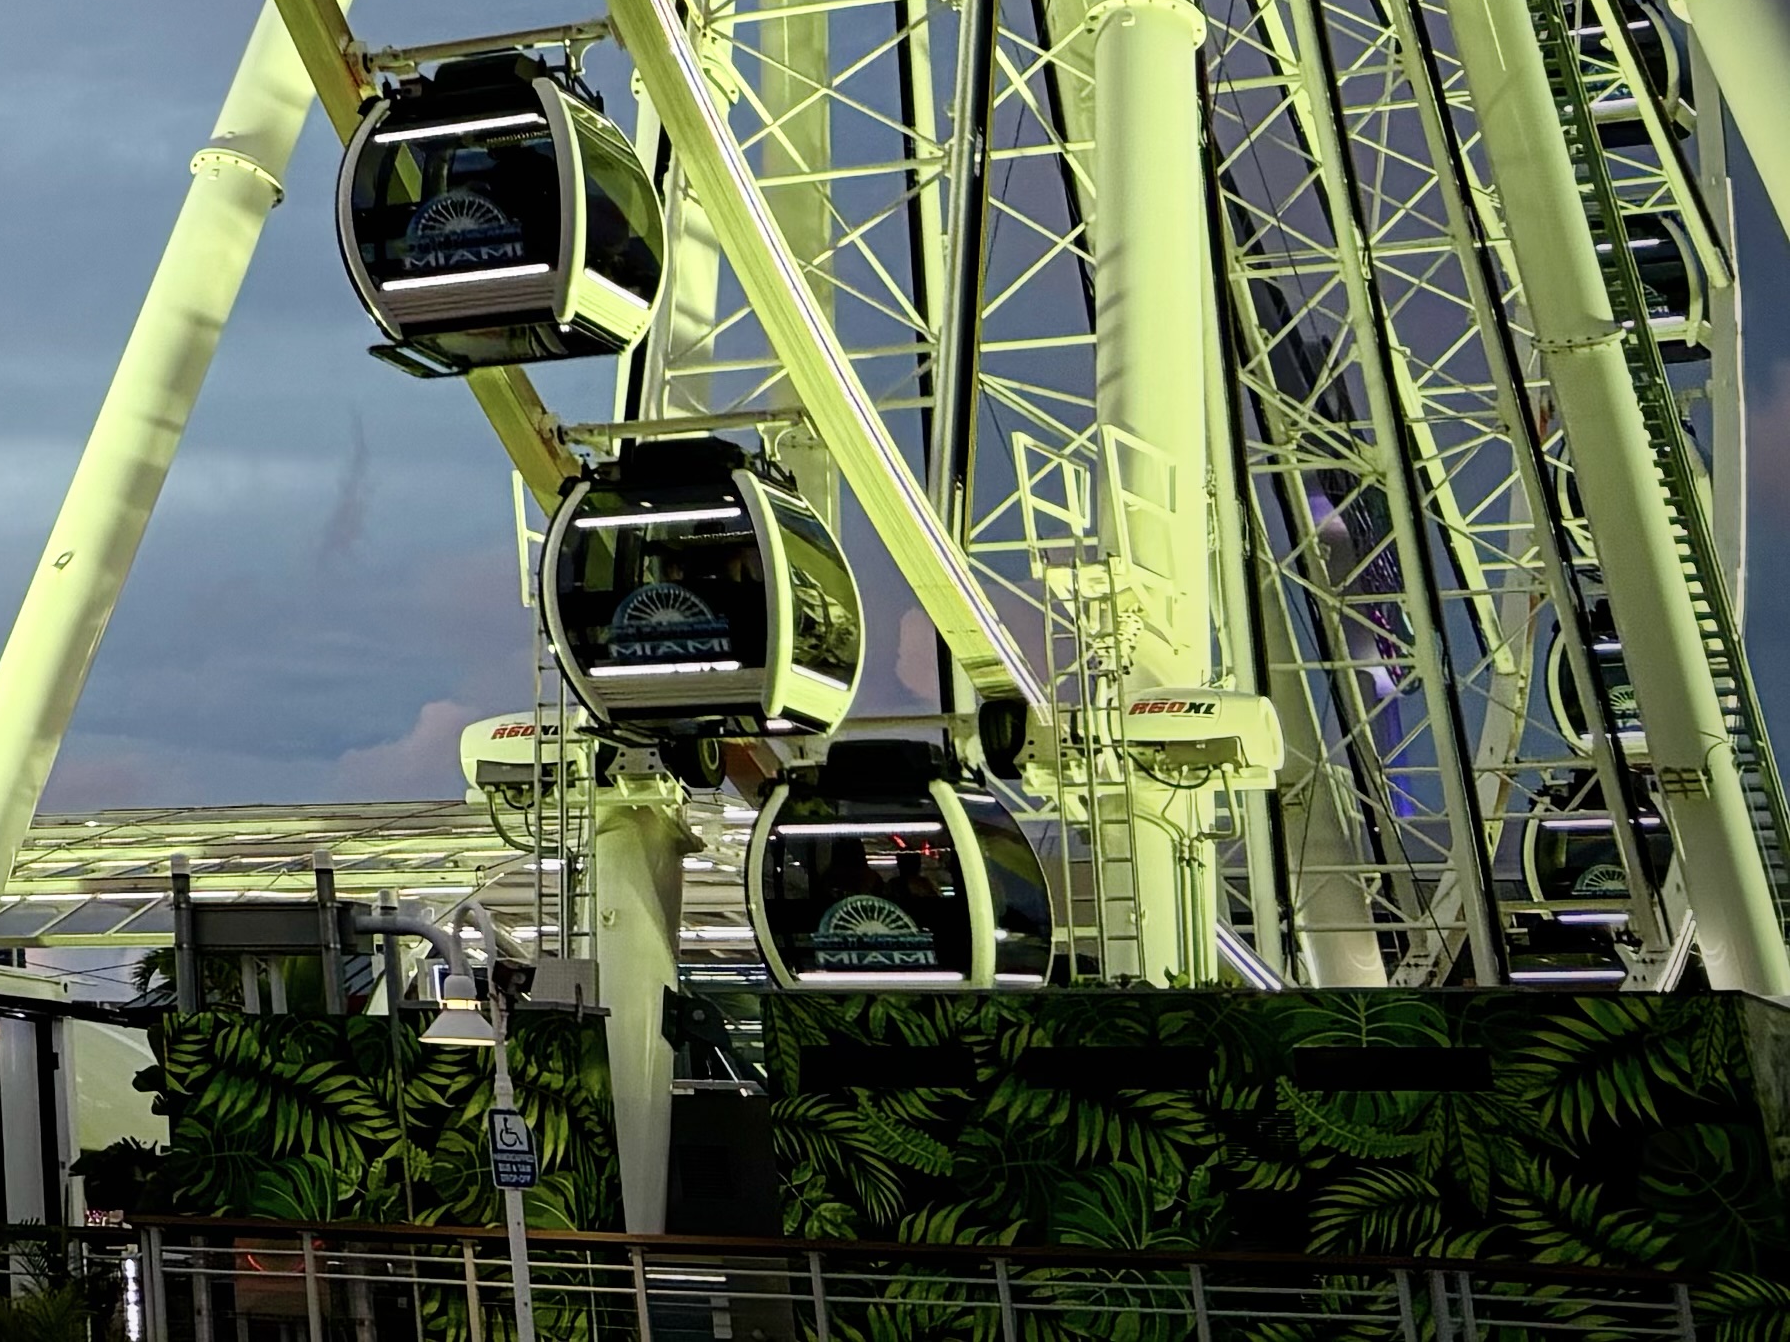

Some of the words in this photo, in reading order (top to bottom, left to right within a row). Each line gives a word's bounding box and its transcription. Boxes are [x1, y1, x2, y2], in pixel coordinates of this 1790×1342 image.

[404, 241, 524, 272] MIAMI
[610, 636, 732, 656] MIAMI
[1128, 701, 1216, 715] R60XL
[817, 950, 935, 965] MIAMI
